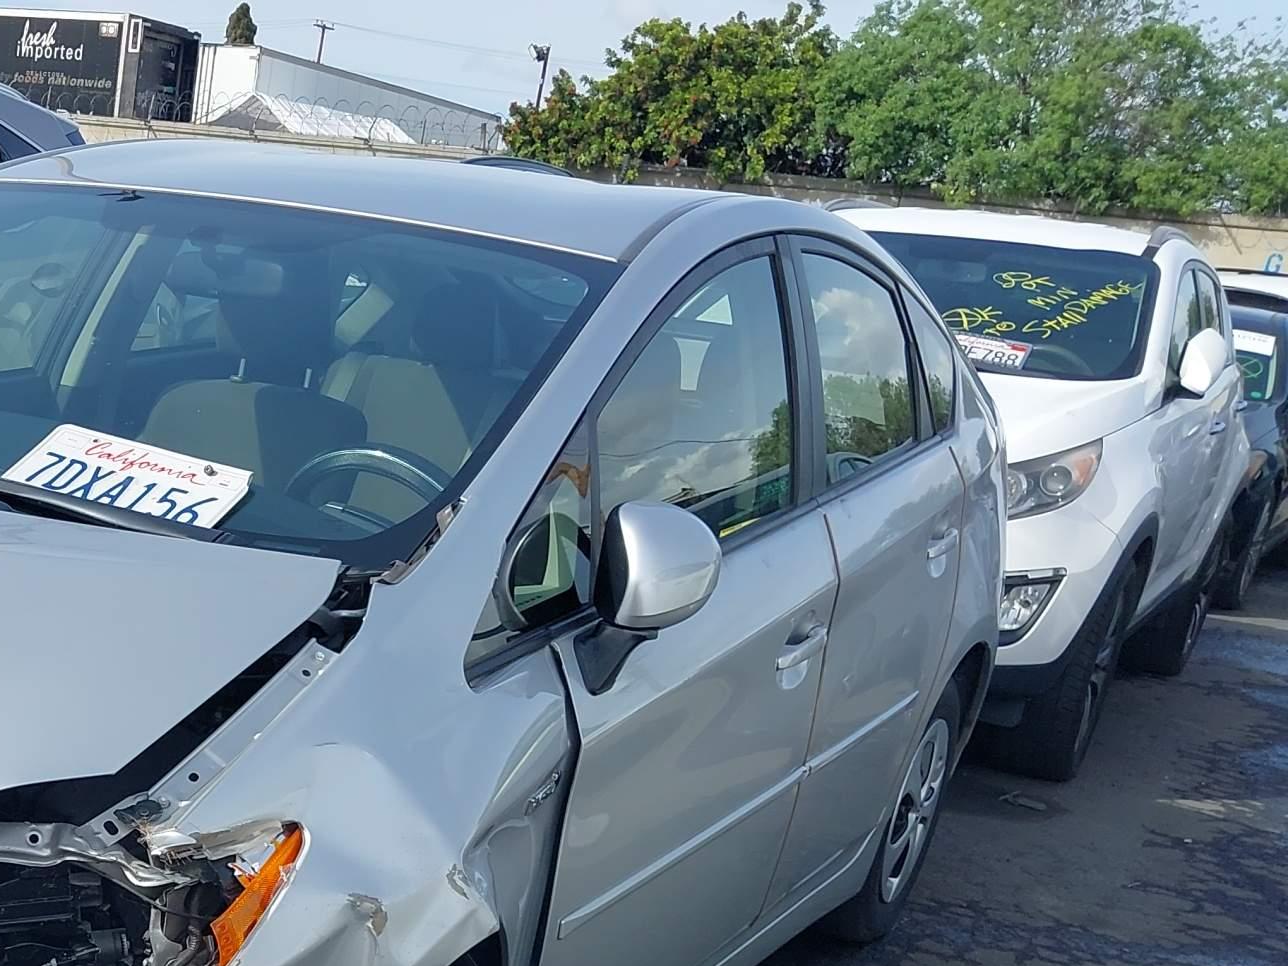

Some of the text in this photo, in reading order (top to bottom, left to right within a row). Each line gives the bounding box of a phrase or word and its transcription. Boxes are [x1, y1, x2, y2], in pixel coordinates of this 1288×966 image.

[16, 40, 83, 61] imported
[20, 19, 57, 48] fresh
[85, 441, 206, 486] California
[25, 451, 219, 527] 7DXA156
